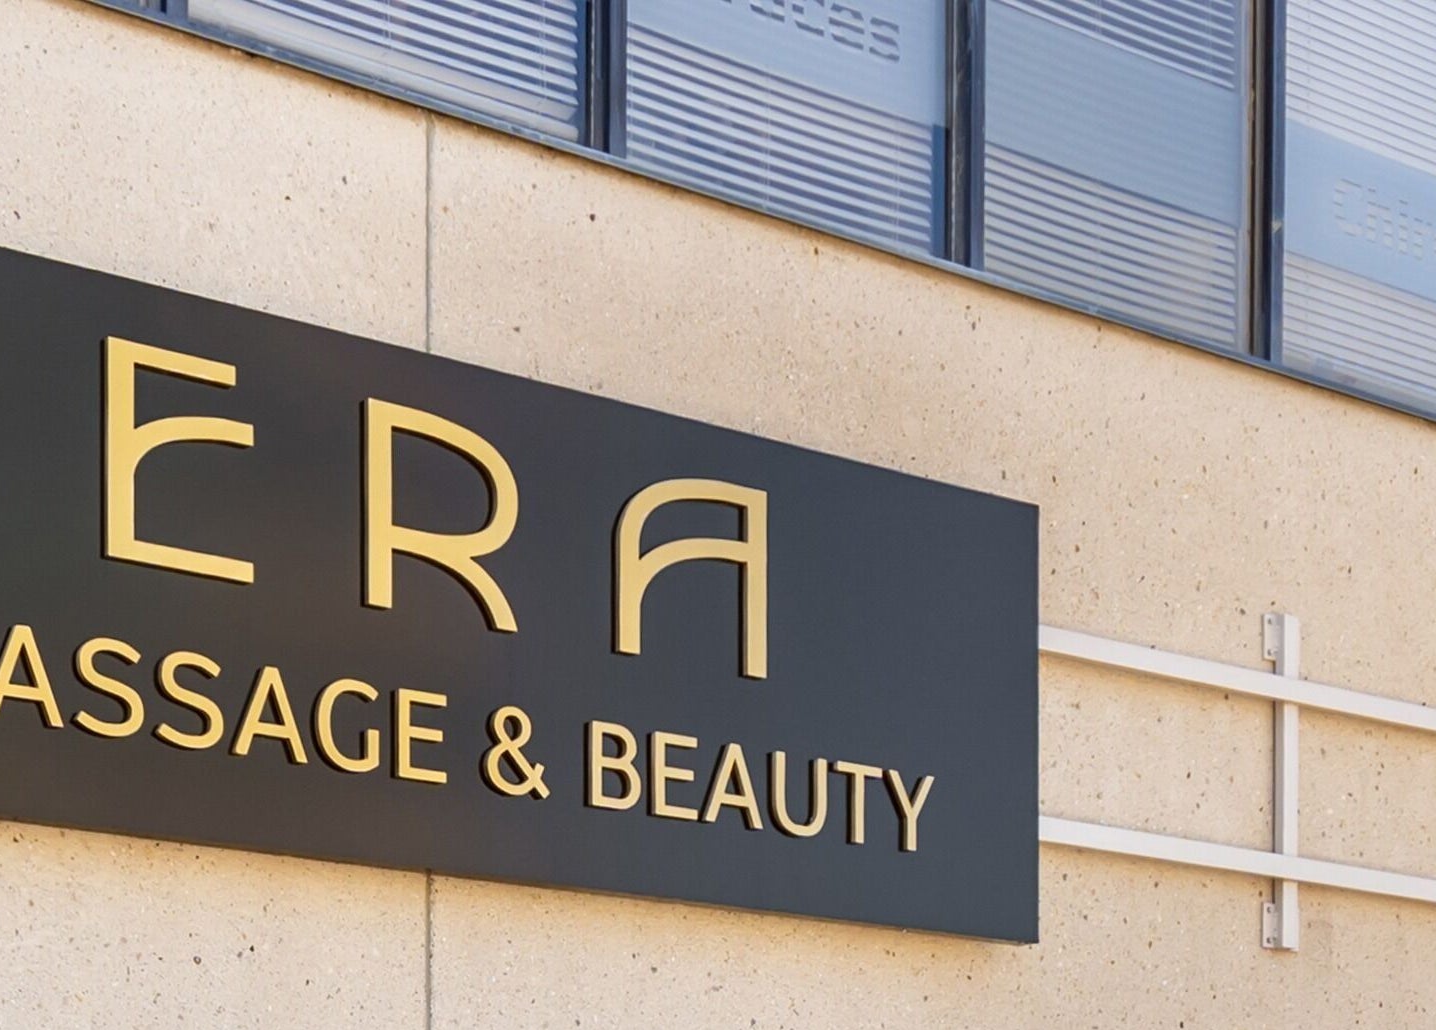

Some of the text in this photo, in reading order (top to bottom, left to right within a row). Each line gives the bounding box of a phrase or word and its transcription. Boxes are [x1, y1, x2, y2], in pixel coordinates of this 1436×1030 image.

[102, 335, 768, 680] ERA
[481, 705, 551, 800] &
[585, 719, 935, 852] BEAUTY
